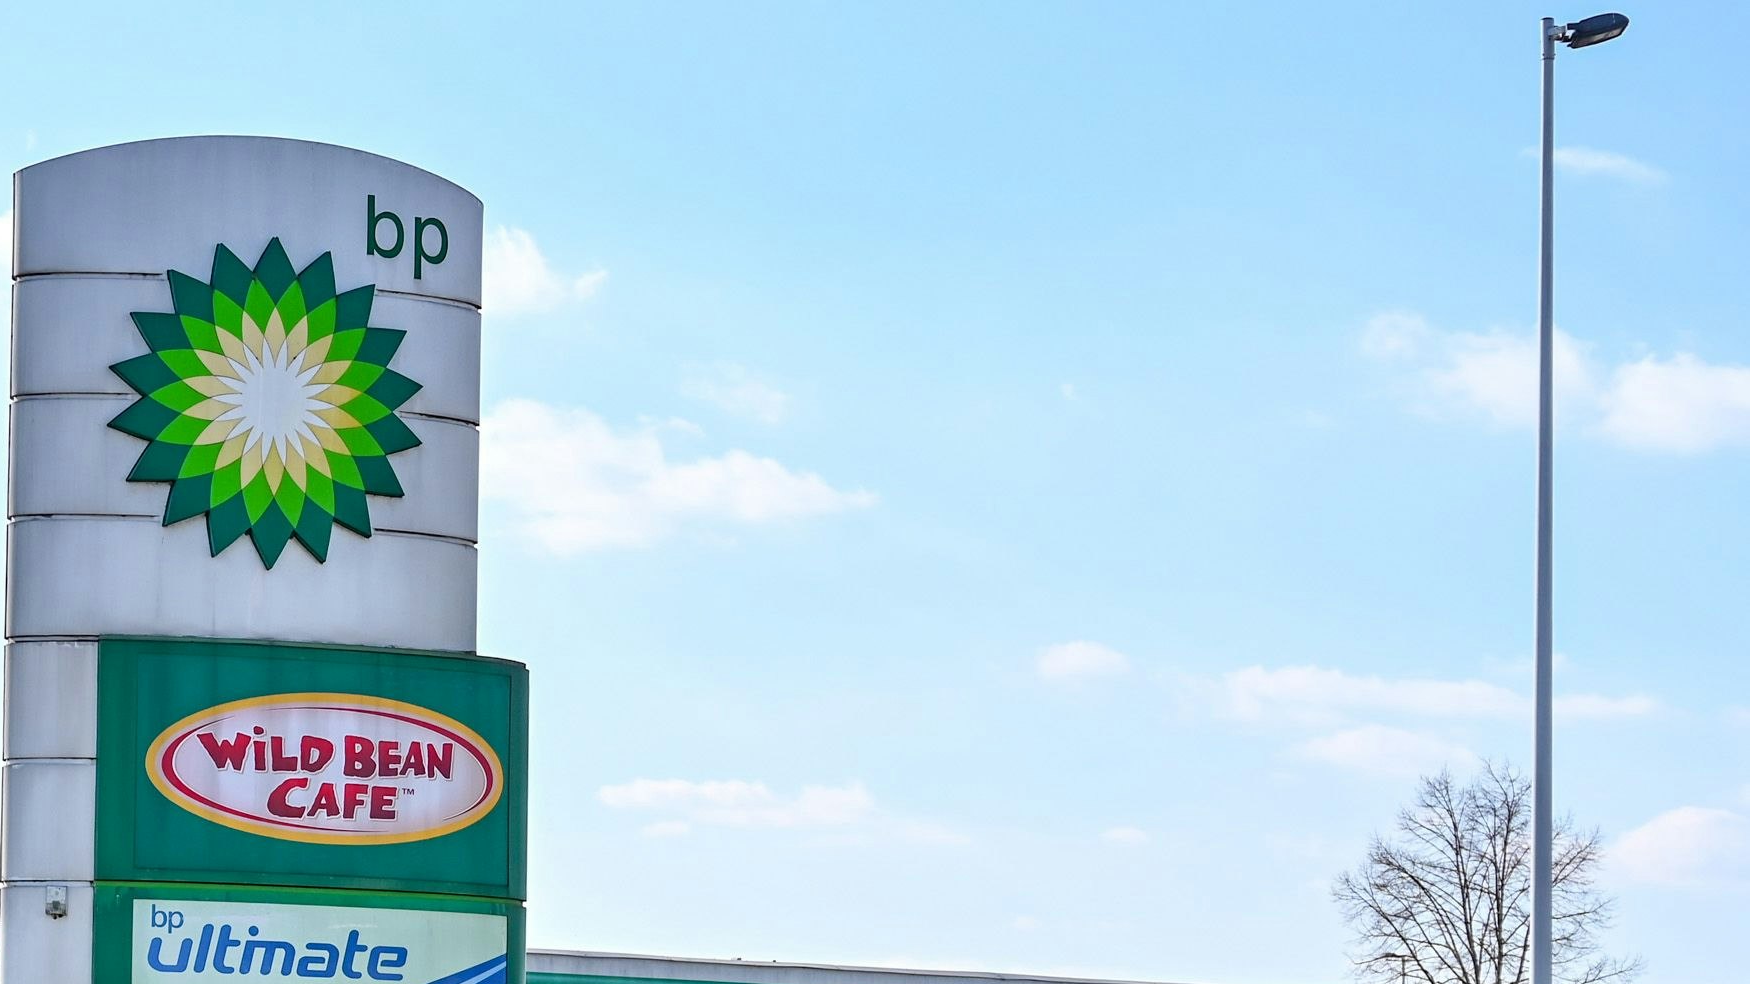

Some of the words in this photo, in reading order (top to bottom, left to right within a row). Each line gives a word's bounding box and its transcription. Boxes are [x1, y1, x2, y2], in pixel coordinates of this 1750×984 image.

[367, 194, 449, 280] bp
[343, 735, 454, 780] BEAN
[151, 904, 184, 933] bp
